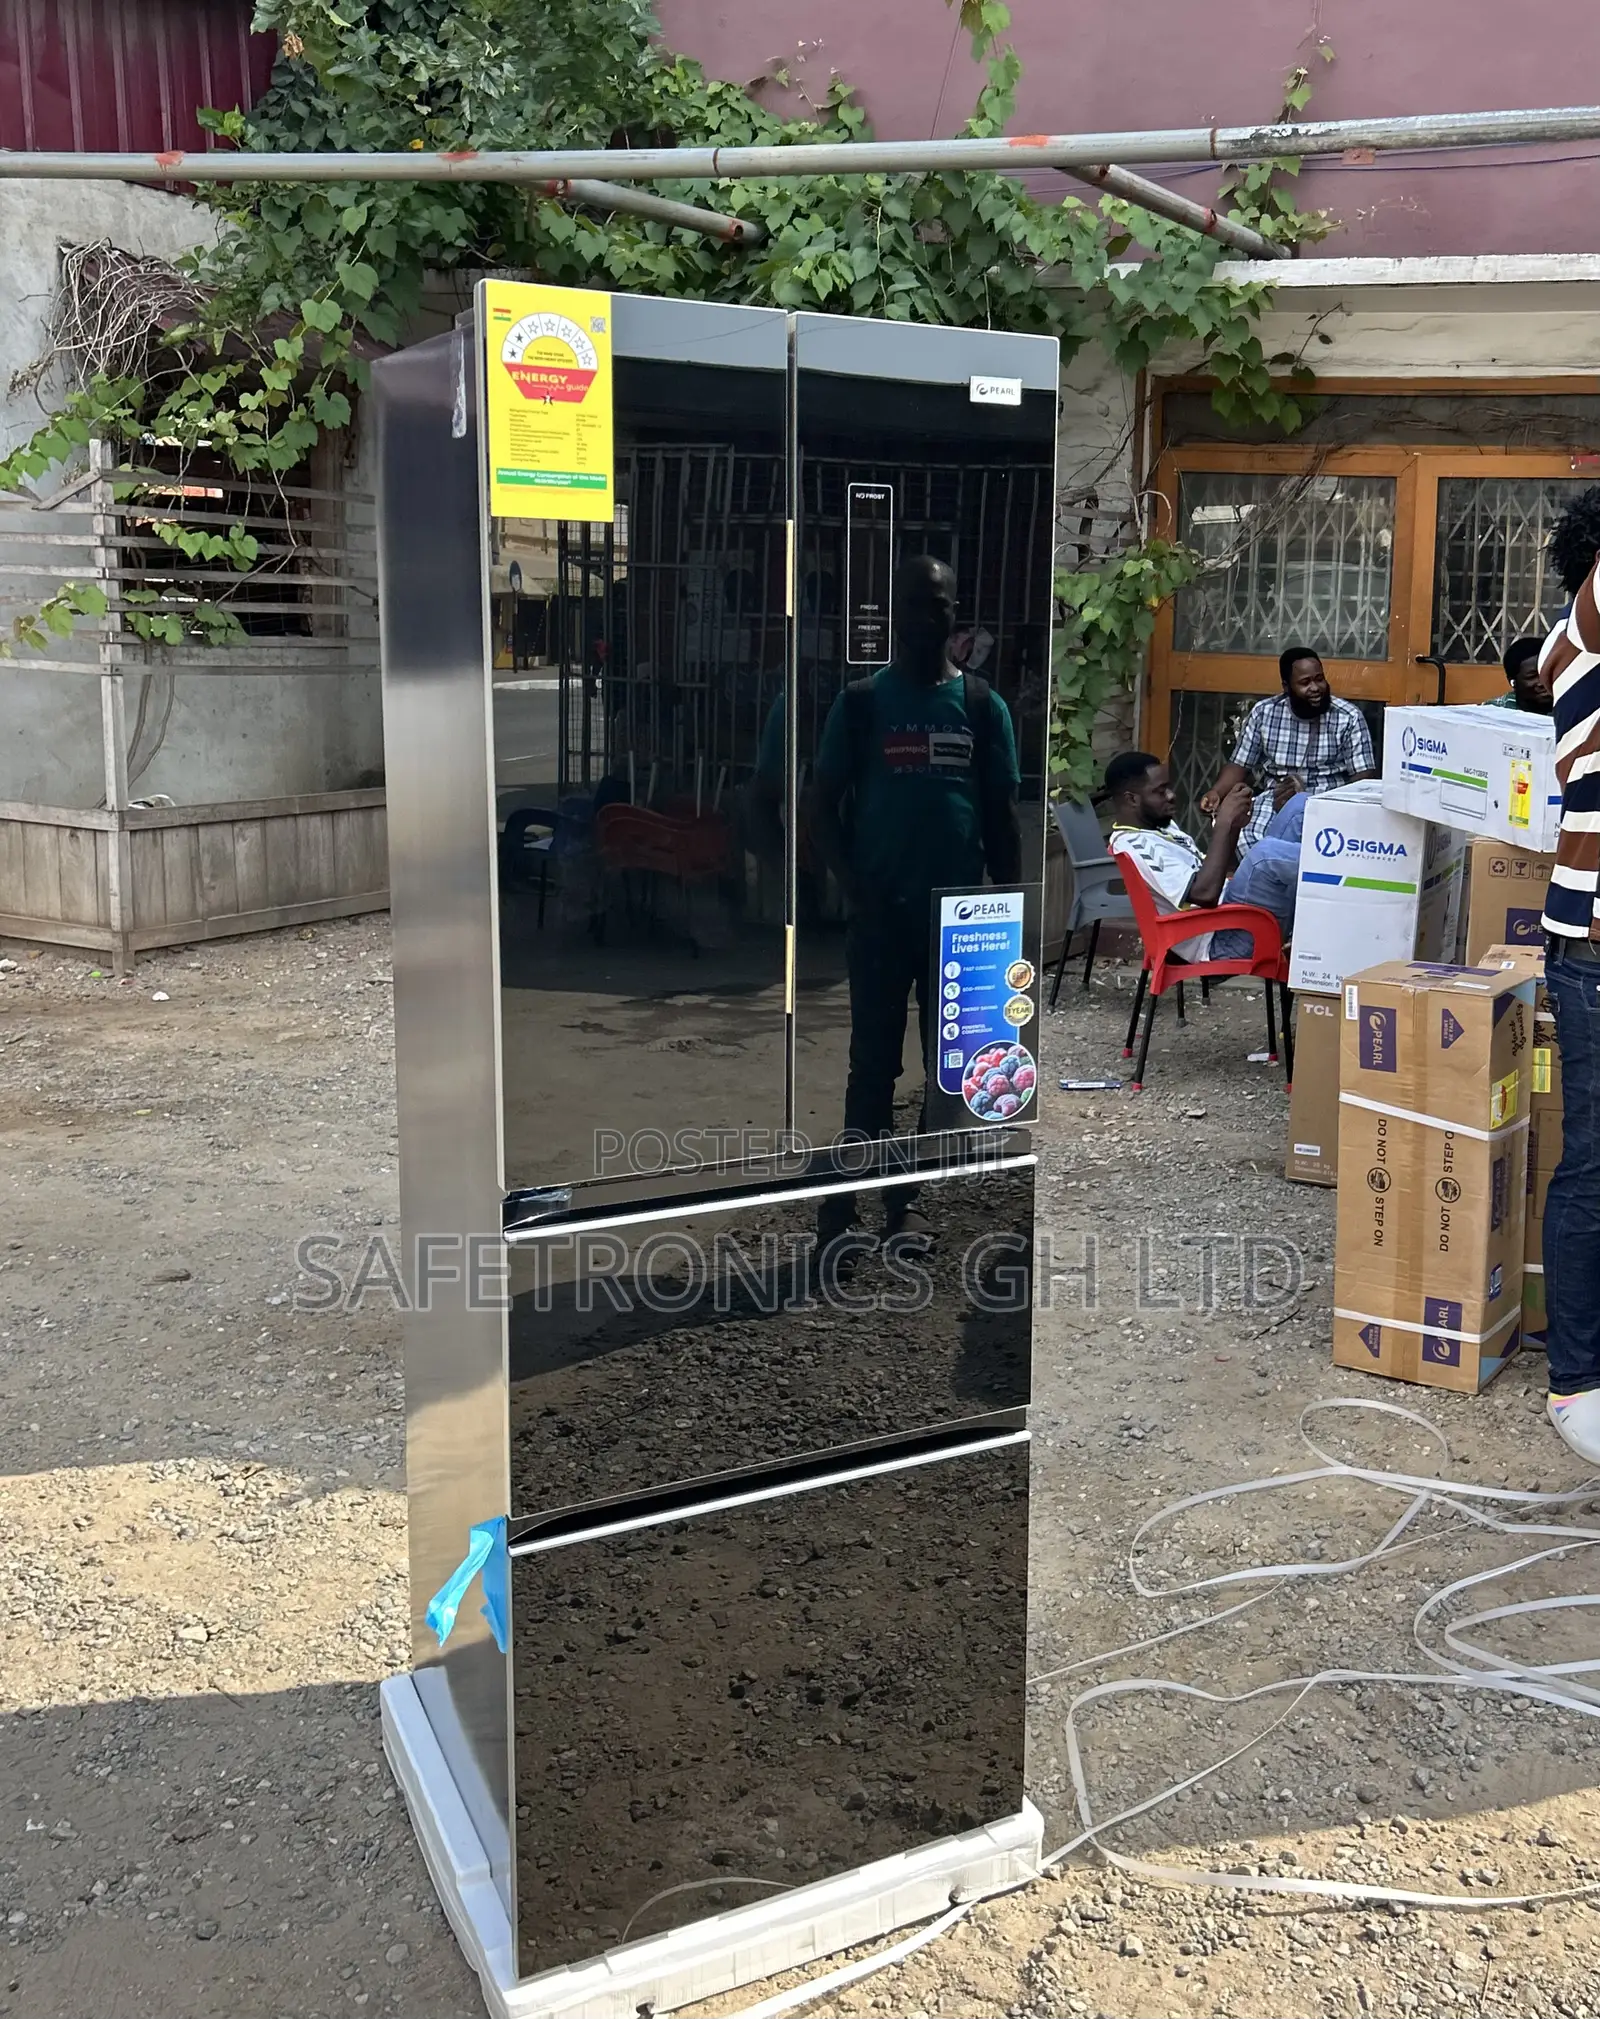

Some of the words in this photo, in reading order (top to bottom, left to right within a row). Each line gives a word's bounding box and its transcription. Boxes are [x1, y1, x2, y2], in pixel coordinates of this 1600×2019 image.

[511, 370, 568, 385] ENERGY
[990, 386, 1015, 396] PEARL
[1417, 737, 1448, 756] SIGMA
[1346, 839, 1408, 857] SIGMA
[974, 902, 1011, 915] PEARL
[952, 931, 1007, 943] Freshness
[951, 943, 980, 954] Lives
[981, 940, 1010, 952] Here!
[1322, 972, 1331, 980] 24
[1013, 1006, 1029, 1014] YEAR
[1304, 1004, 1334, 1017] TCL
[1372, 1030, 1383, 1066] PEARL
[1378, 1118, 1387, 1136] DO
[1445, 1130, 1454, 1140] O
[1376, 1139, 1386, 1164] NOT
[1443, 1142, 1454, 1173] STEP
[1374, 1196, 1384, 1227] STEP
[1440, 1206, 1451, 1232] NOT
[1374, 1229, 1383, 1247] ON
[1439, 1234, 1449, 1252] DO
